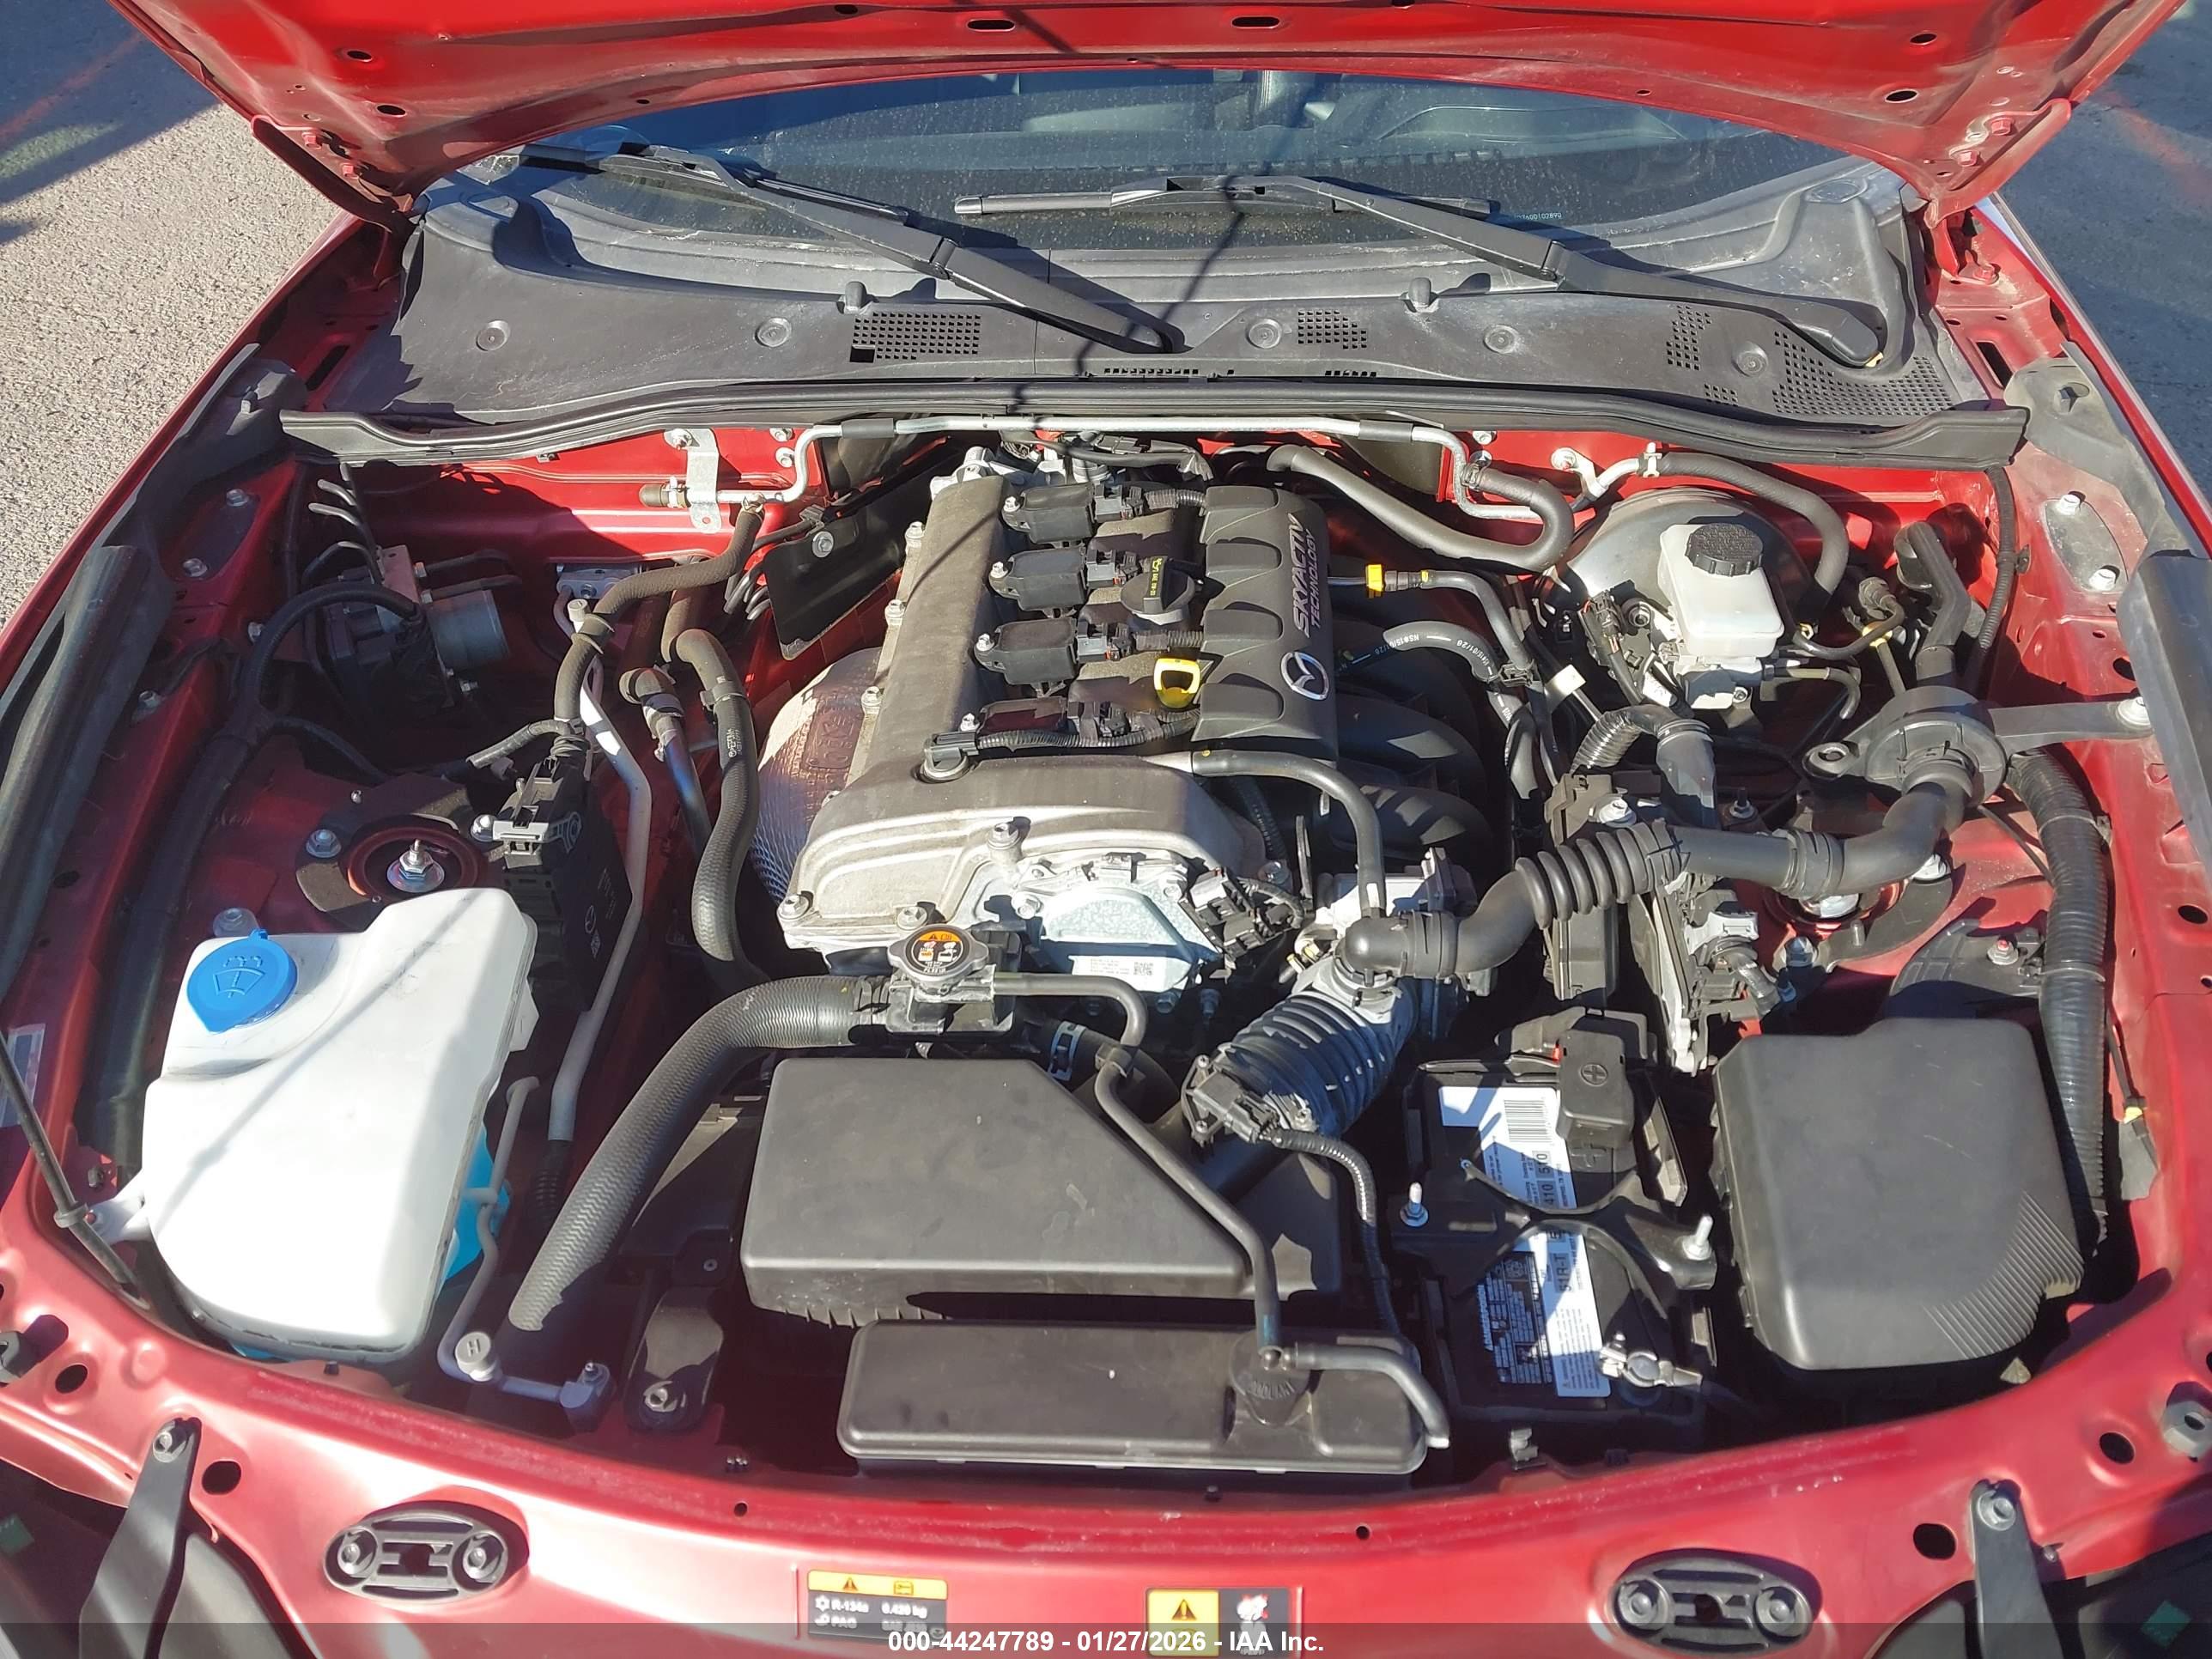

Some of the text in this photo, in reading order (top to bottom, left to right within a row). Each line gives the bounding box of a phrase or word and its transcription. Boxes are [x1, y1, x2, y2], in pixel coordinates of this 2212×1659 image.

[1288, 513, 1310, 638] SKYACTIV
[1305, 529, 1321, 629] TECHNOLOGY
[1536, 1153, 1551, 1174] 510
[1541, 1184, 1555, 1205] 410
[1553, 1255, 1571, 1291] 51R-T
[466, 1339, 481, 1357] H
[1248, 1380, 1295, 1400] COOLANT
[831, 1599, 869, 1613] R-134a
